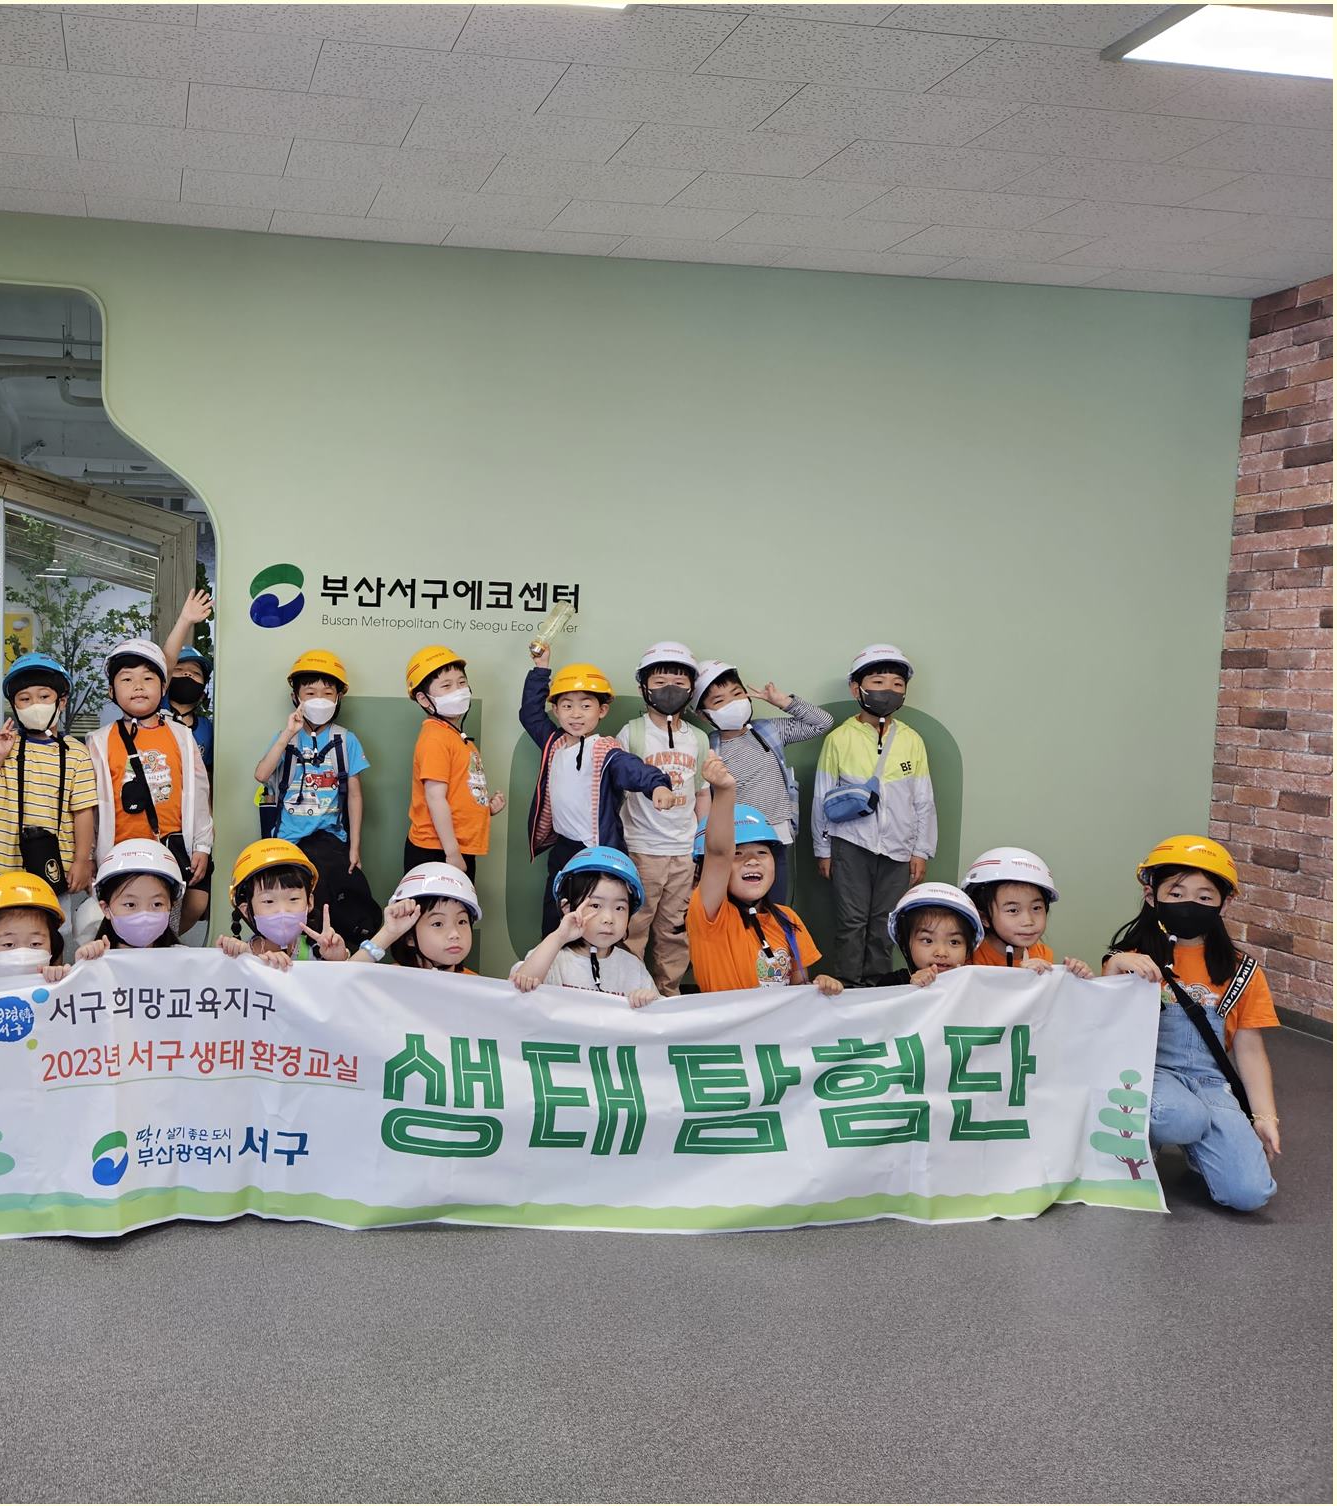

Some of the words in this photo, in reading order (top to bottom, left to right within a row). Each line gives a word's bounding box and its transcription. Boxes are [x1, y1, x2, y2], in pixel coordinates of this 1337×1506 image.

[320, 575, 580, 613] 부산서구에코센터
[322, 614, 358, 627] Busan
[361, 615, 440, 630] Metropolitan
[443, 618, 467, 633] City
[469, 620, 508, 634] Seogu
[511, 621, 534, 632] Eco
[41, 1042, 121, 1082] 2023년
[128, 1040, 185, 1072] 서구
[136, 1124, 162, 1147] 딱!
[166, 1126, 185, 1140] 살기
[188, 1127, 208, 1141] 좋은
[212, 1127, 232, 1141] 도시
[137, 1143, 232, 1167] 부산광역시
[238, 1126, 309, 1166] 서구
